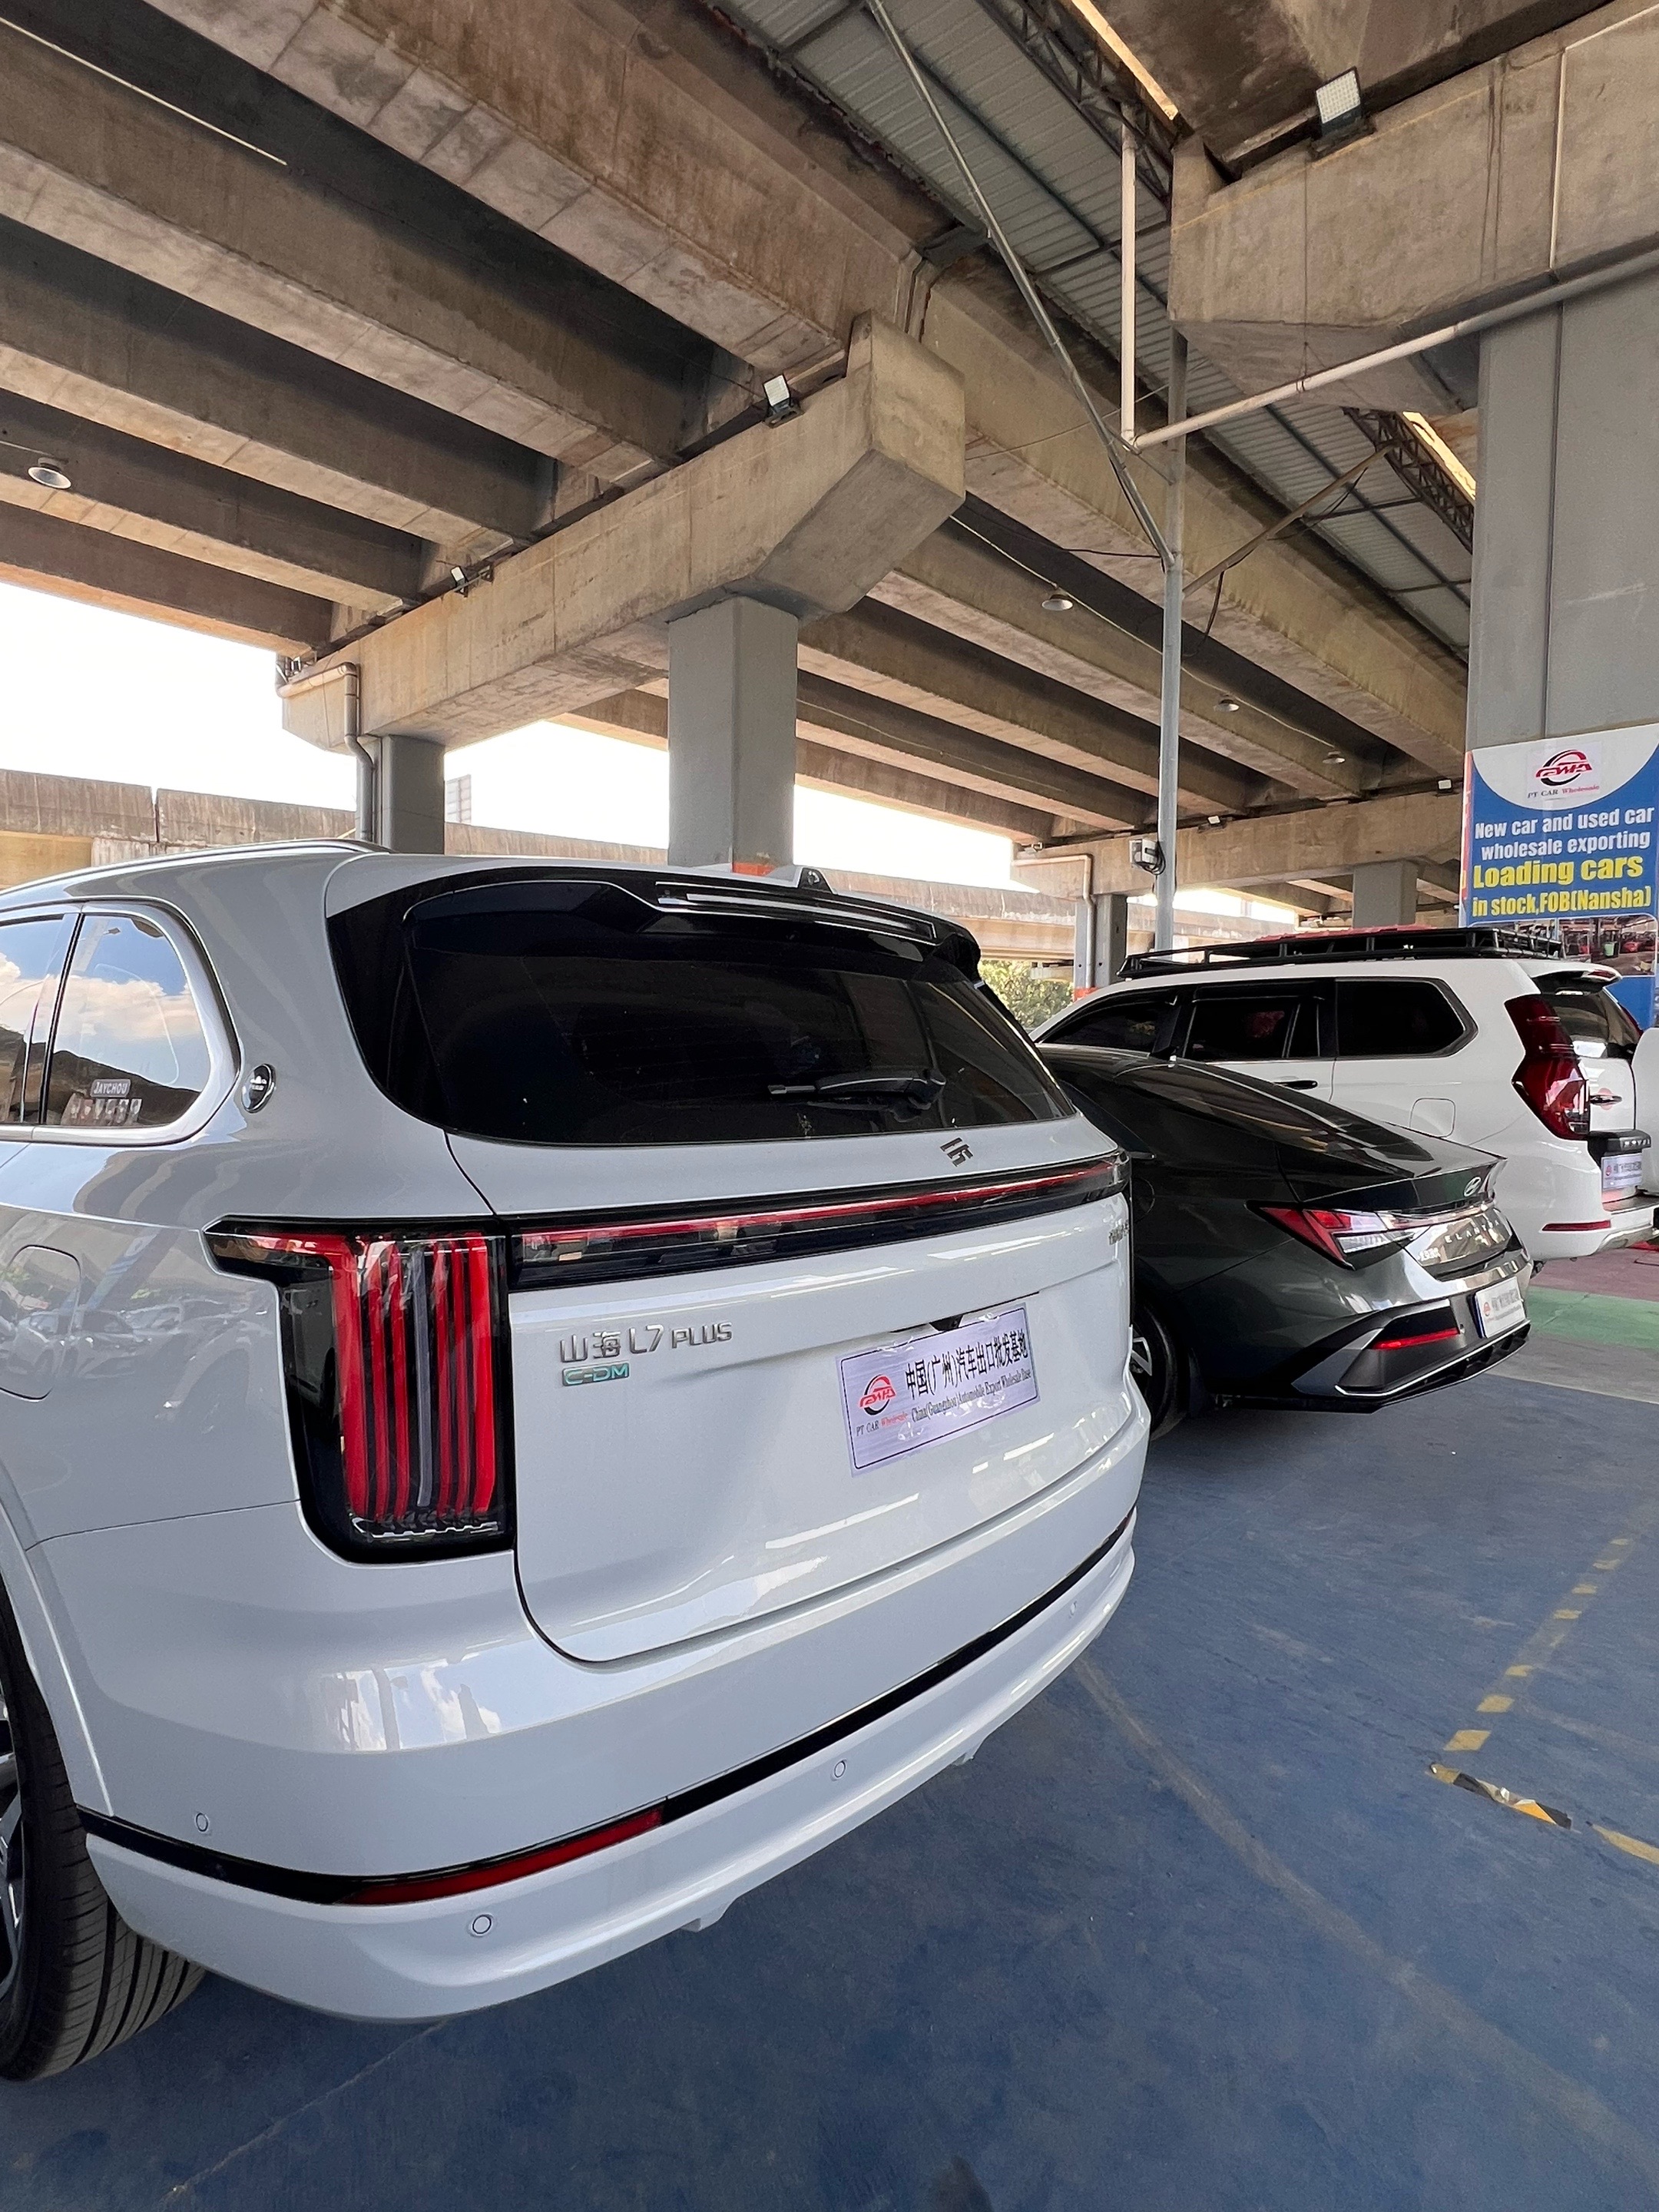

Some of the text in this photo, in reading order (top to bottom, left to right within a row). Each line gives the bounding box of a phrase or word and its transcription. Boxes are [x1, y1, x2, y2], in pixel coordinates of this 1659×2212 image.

[1475, 806, 1655, 839] New car and used car
[1481, 830, 1651, 861] wholesale exporting
[1473, 856, 1644, 889] Loading cars
[1472, 896, 1488, 917] in
[671, 1322, 732, 1349] PLUS
[564, 1366, 629, 1385] C-DM
[905, 1329, 1028, 1400] 中国(广州)汽车出口批发基地
[985, 1379, 1002, 1395] Export
[1022, 1368, 1031, 1382] Base
[856, 1424, 865, 1436] PT
[866, 1419, 879, 1433] CAR
